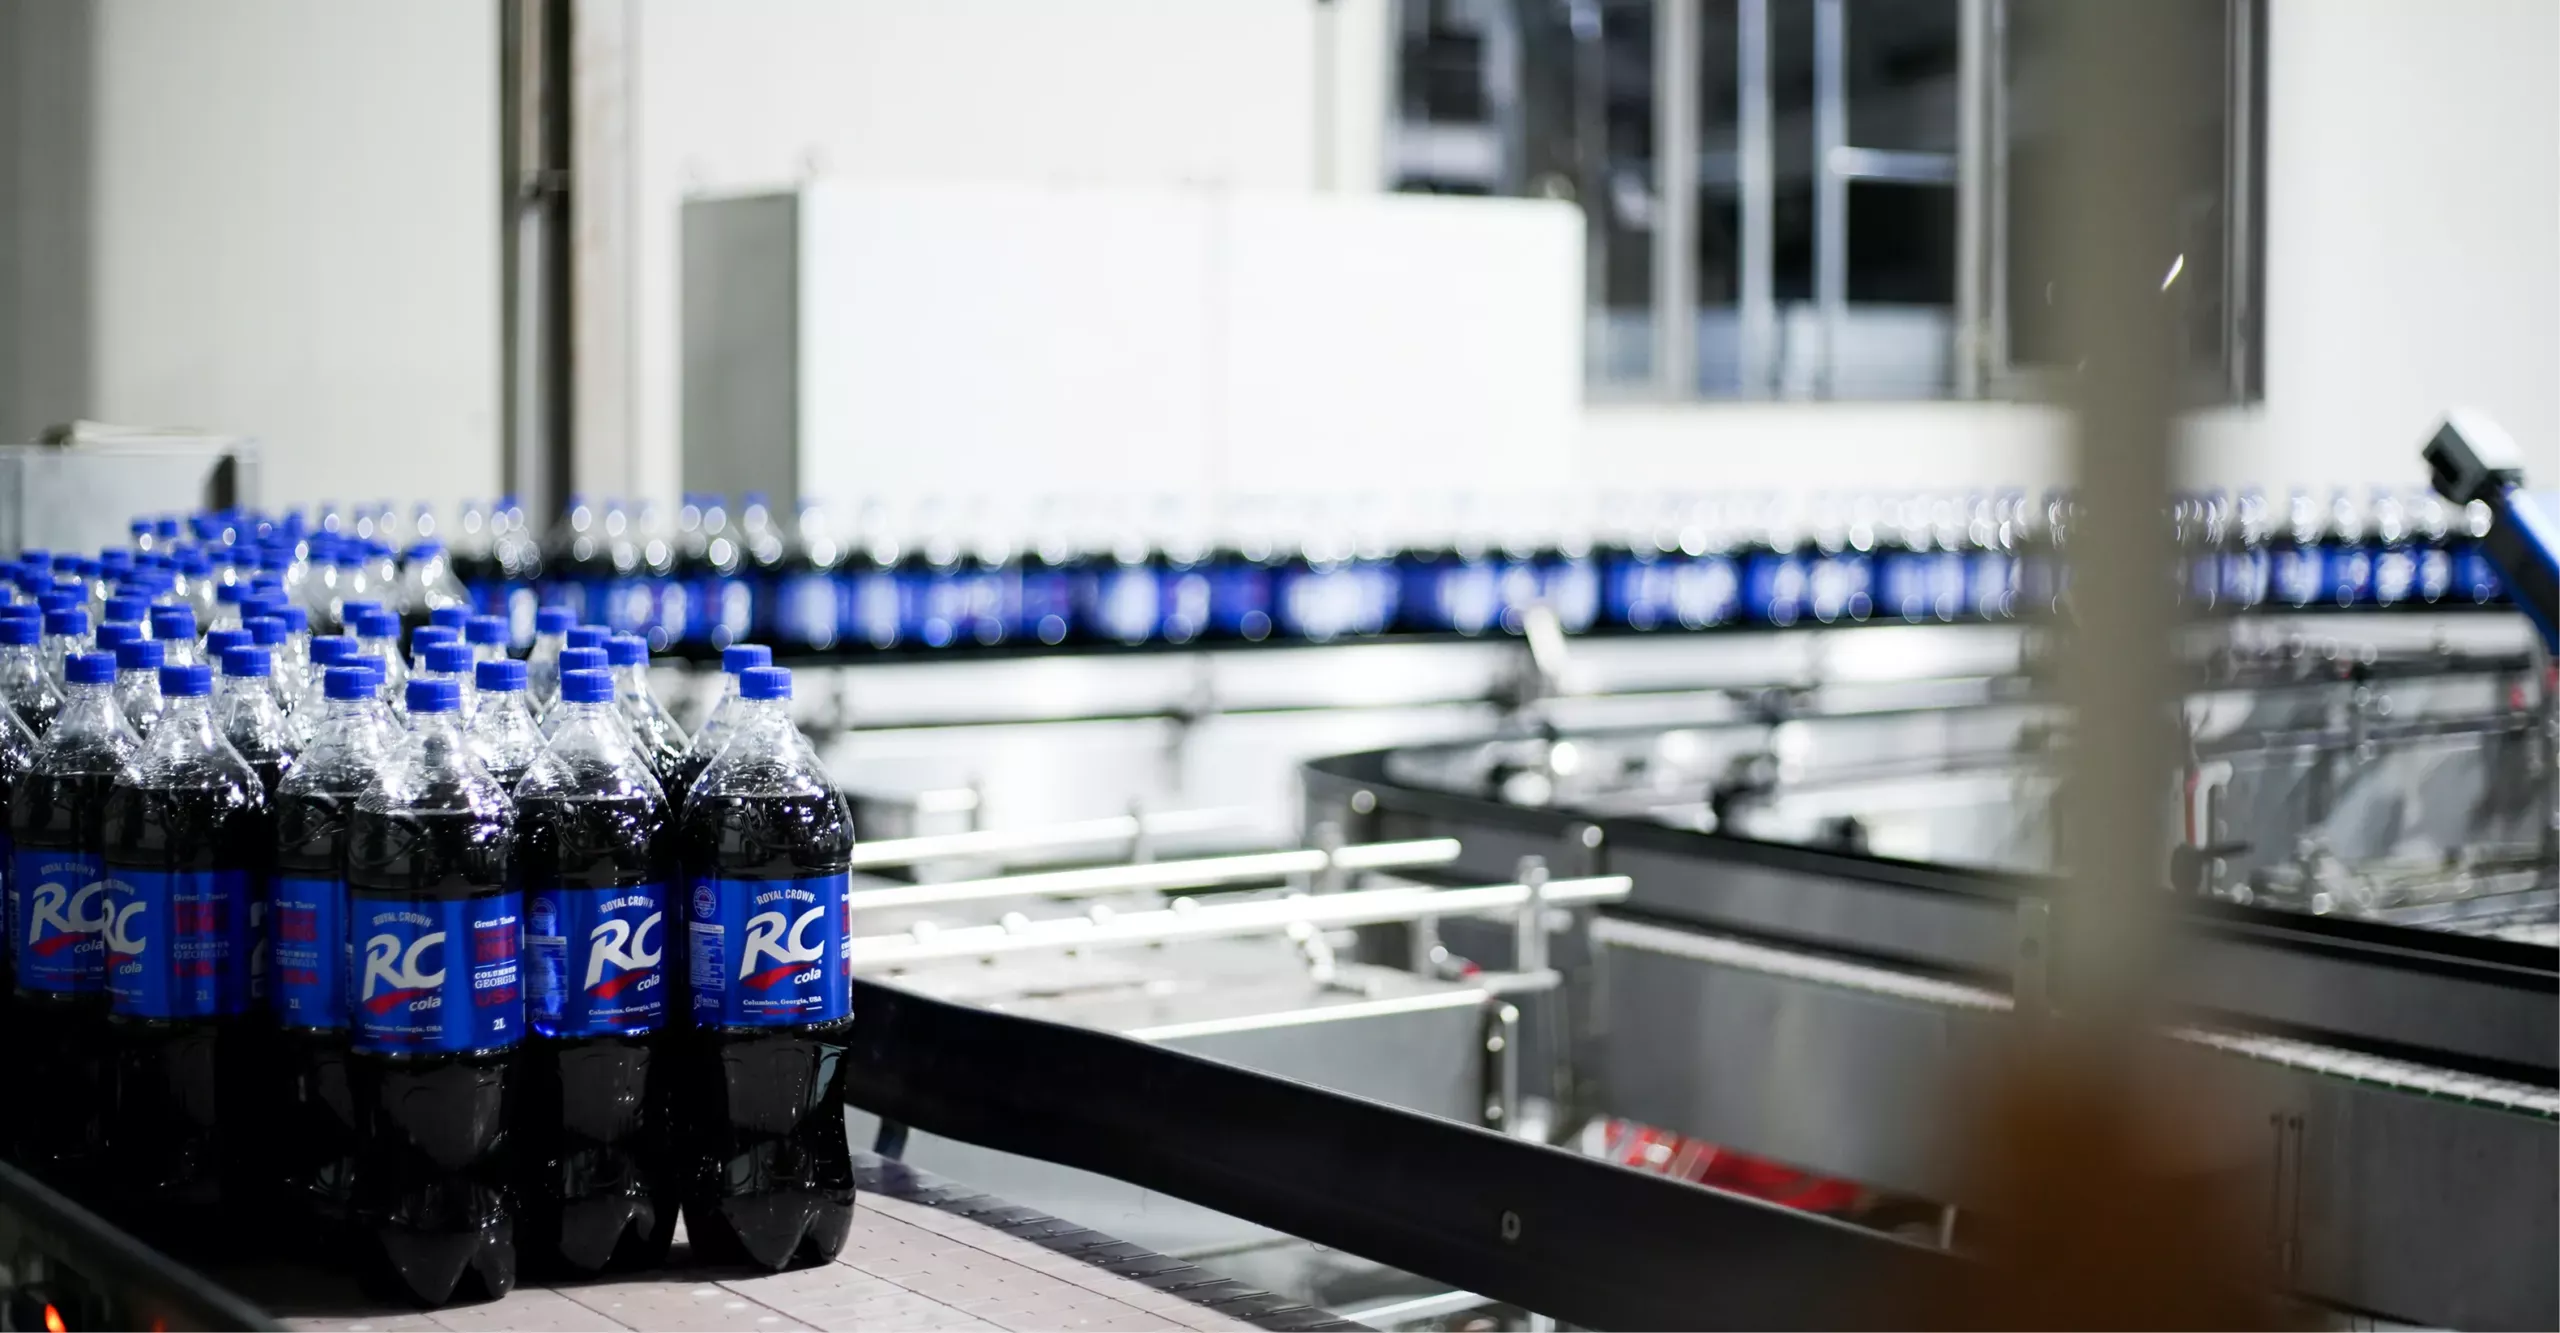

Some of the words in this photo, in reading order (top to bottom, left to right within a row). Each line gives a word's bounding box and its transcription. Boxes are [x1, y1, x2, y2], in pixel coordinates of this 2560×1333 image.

[600, 896, 627, 915] ROYAL
[627, 895, 655, 909] CROWN
[756, 889, 783, 906] ROYAL
[784, 888, 815, 904] CROWN
[373, 912, 397, 927] ROYAL
[399, 911, 432, 928] CROWN
[474, 919, 498, 930] Great
[74, 939, 103, 954] cola
[583, 911, 662, 992] RC
[738, 905, 825, 981] RC
[119, 961, 142, 975] cola
[362, 931, 447, 1002] RC
[474, 965, 518, 980] COLUMBUS
[474, 973, 518, 989] GEORGIA
[637, 973, 660, 992] cola
[793, 967, 822, 985] cola
[408, 995, 442, 1012] cola
[493, 1017, 507, 1031] 2L
